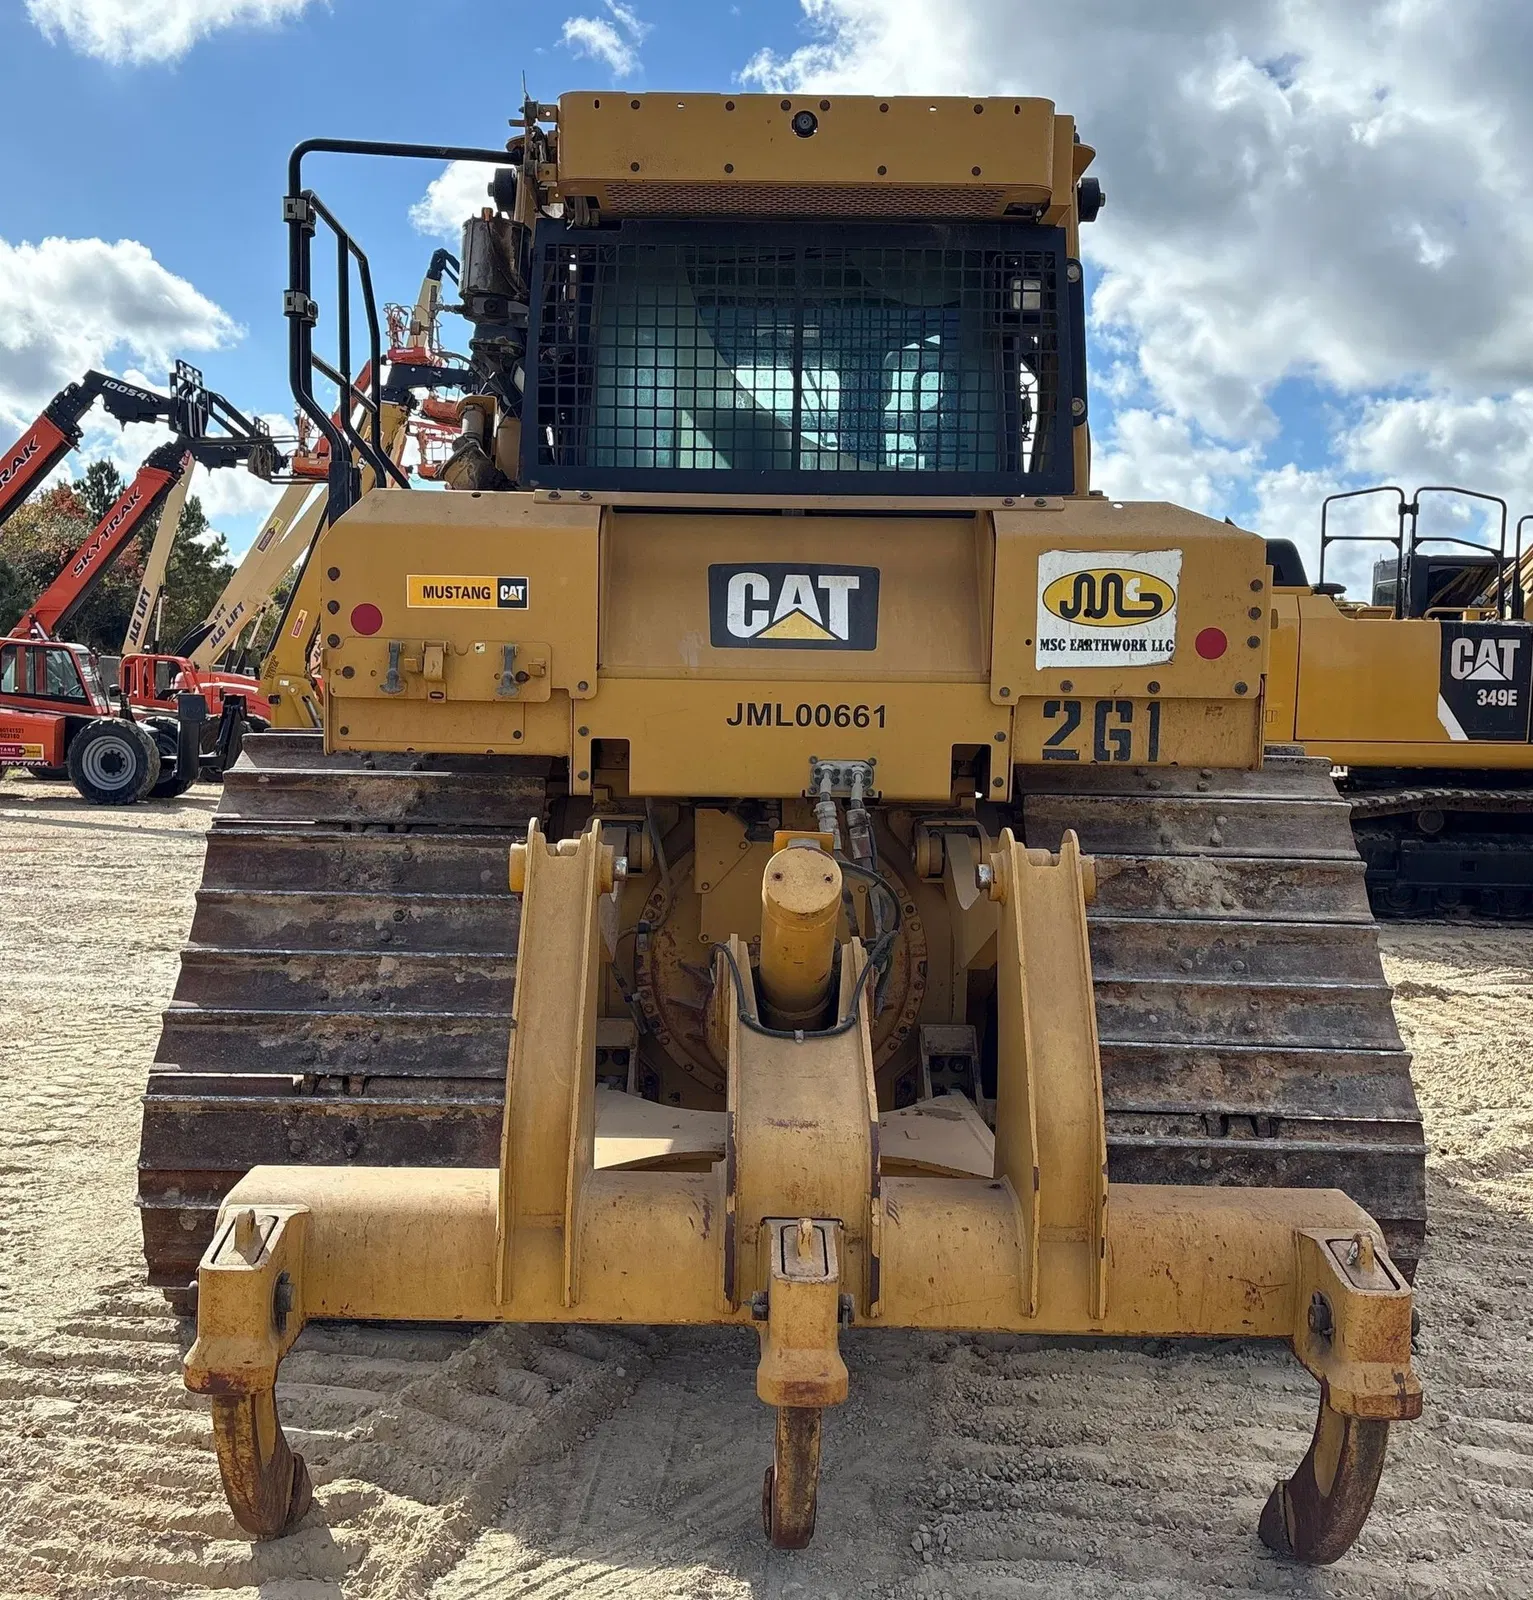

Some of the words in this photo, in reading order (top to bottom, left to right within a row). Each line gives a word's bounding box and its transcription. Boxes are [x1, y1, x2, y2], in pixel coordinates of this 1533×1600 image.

[73, 486, 143, 578] SKYTRAK
[422, 585, 491, 600] MUSTANG
[500, 585, 525, 601] CAT
[727, 572, 859, 640] CAT
[129, 618, 142, 646] JLG
[136, 586, 151, 619] LIFT
[210, 628, 227, 649] JLG
[225, 601, 246, 629] LIFT
[1039, 639, 1067, 652] MSC
[1069, 639, 1148, 652] EARTHWORK
[1151, 639, 1174, 652] LLC
[1450, 637, 1521, 681] CAT
[726, 703, 886, 728] JML00661
[1476, 689, 1518, 707] 349E
